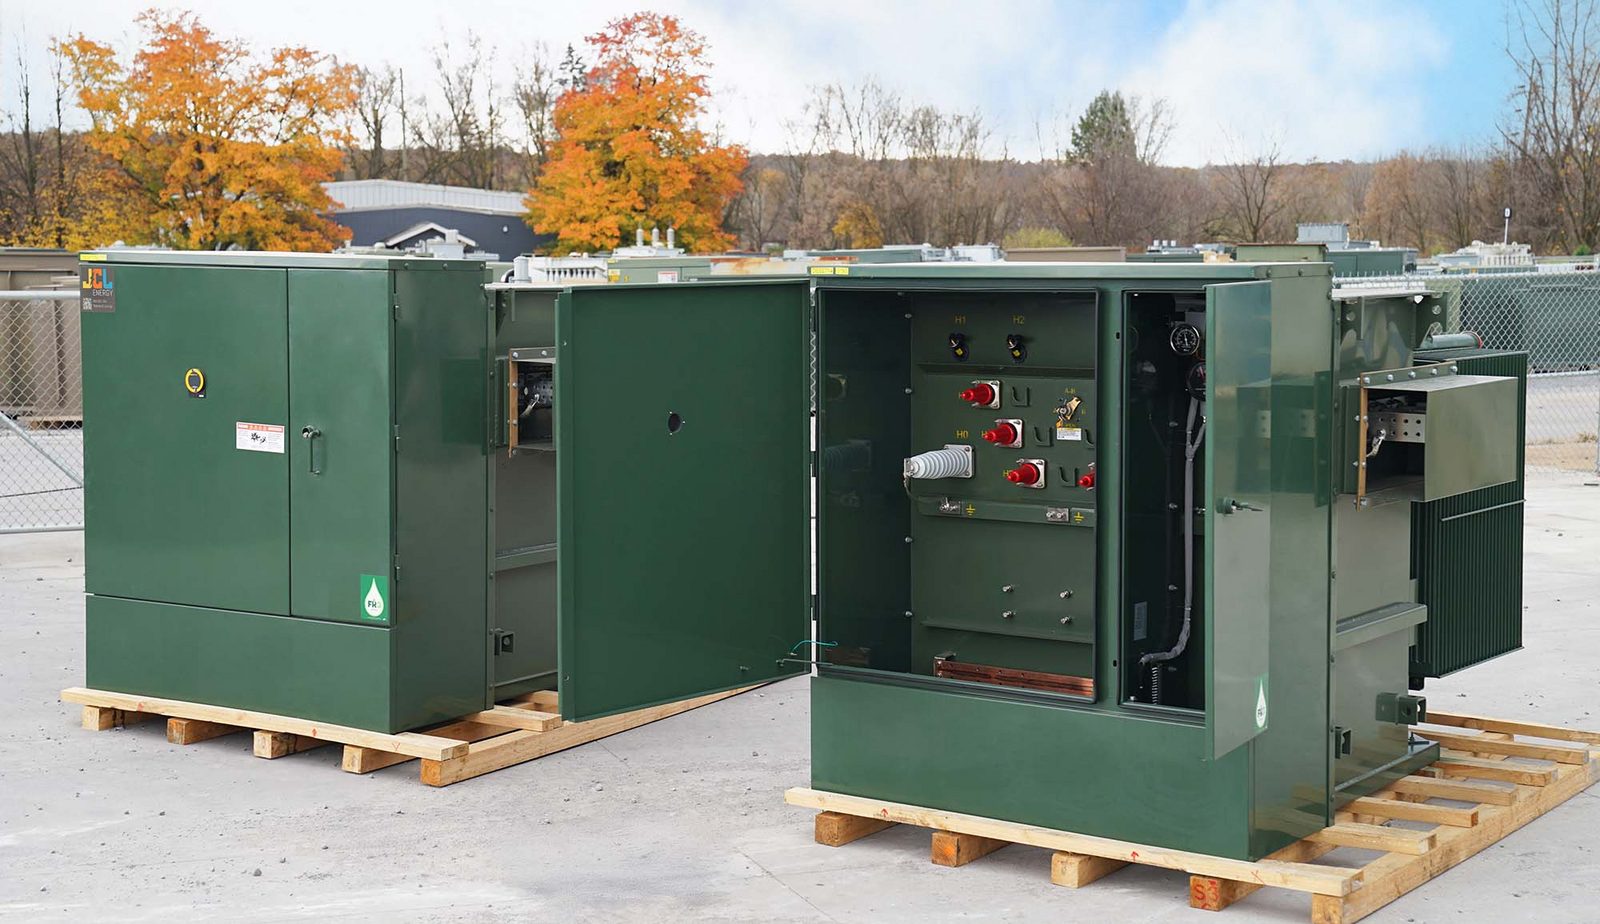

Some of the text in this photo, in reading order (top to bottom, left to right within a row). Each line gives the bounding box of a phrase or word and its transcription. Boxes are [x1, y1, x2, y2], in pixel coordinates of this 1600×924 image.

[83, 268, 113, 289] JCL
[92, 289, 113, 297] ENERGY
[954, 315, 966, 325] H1
[1012, 315, 1025, 325] H2
